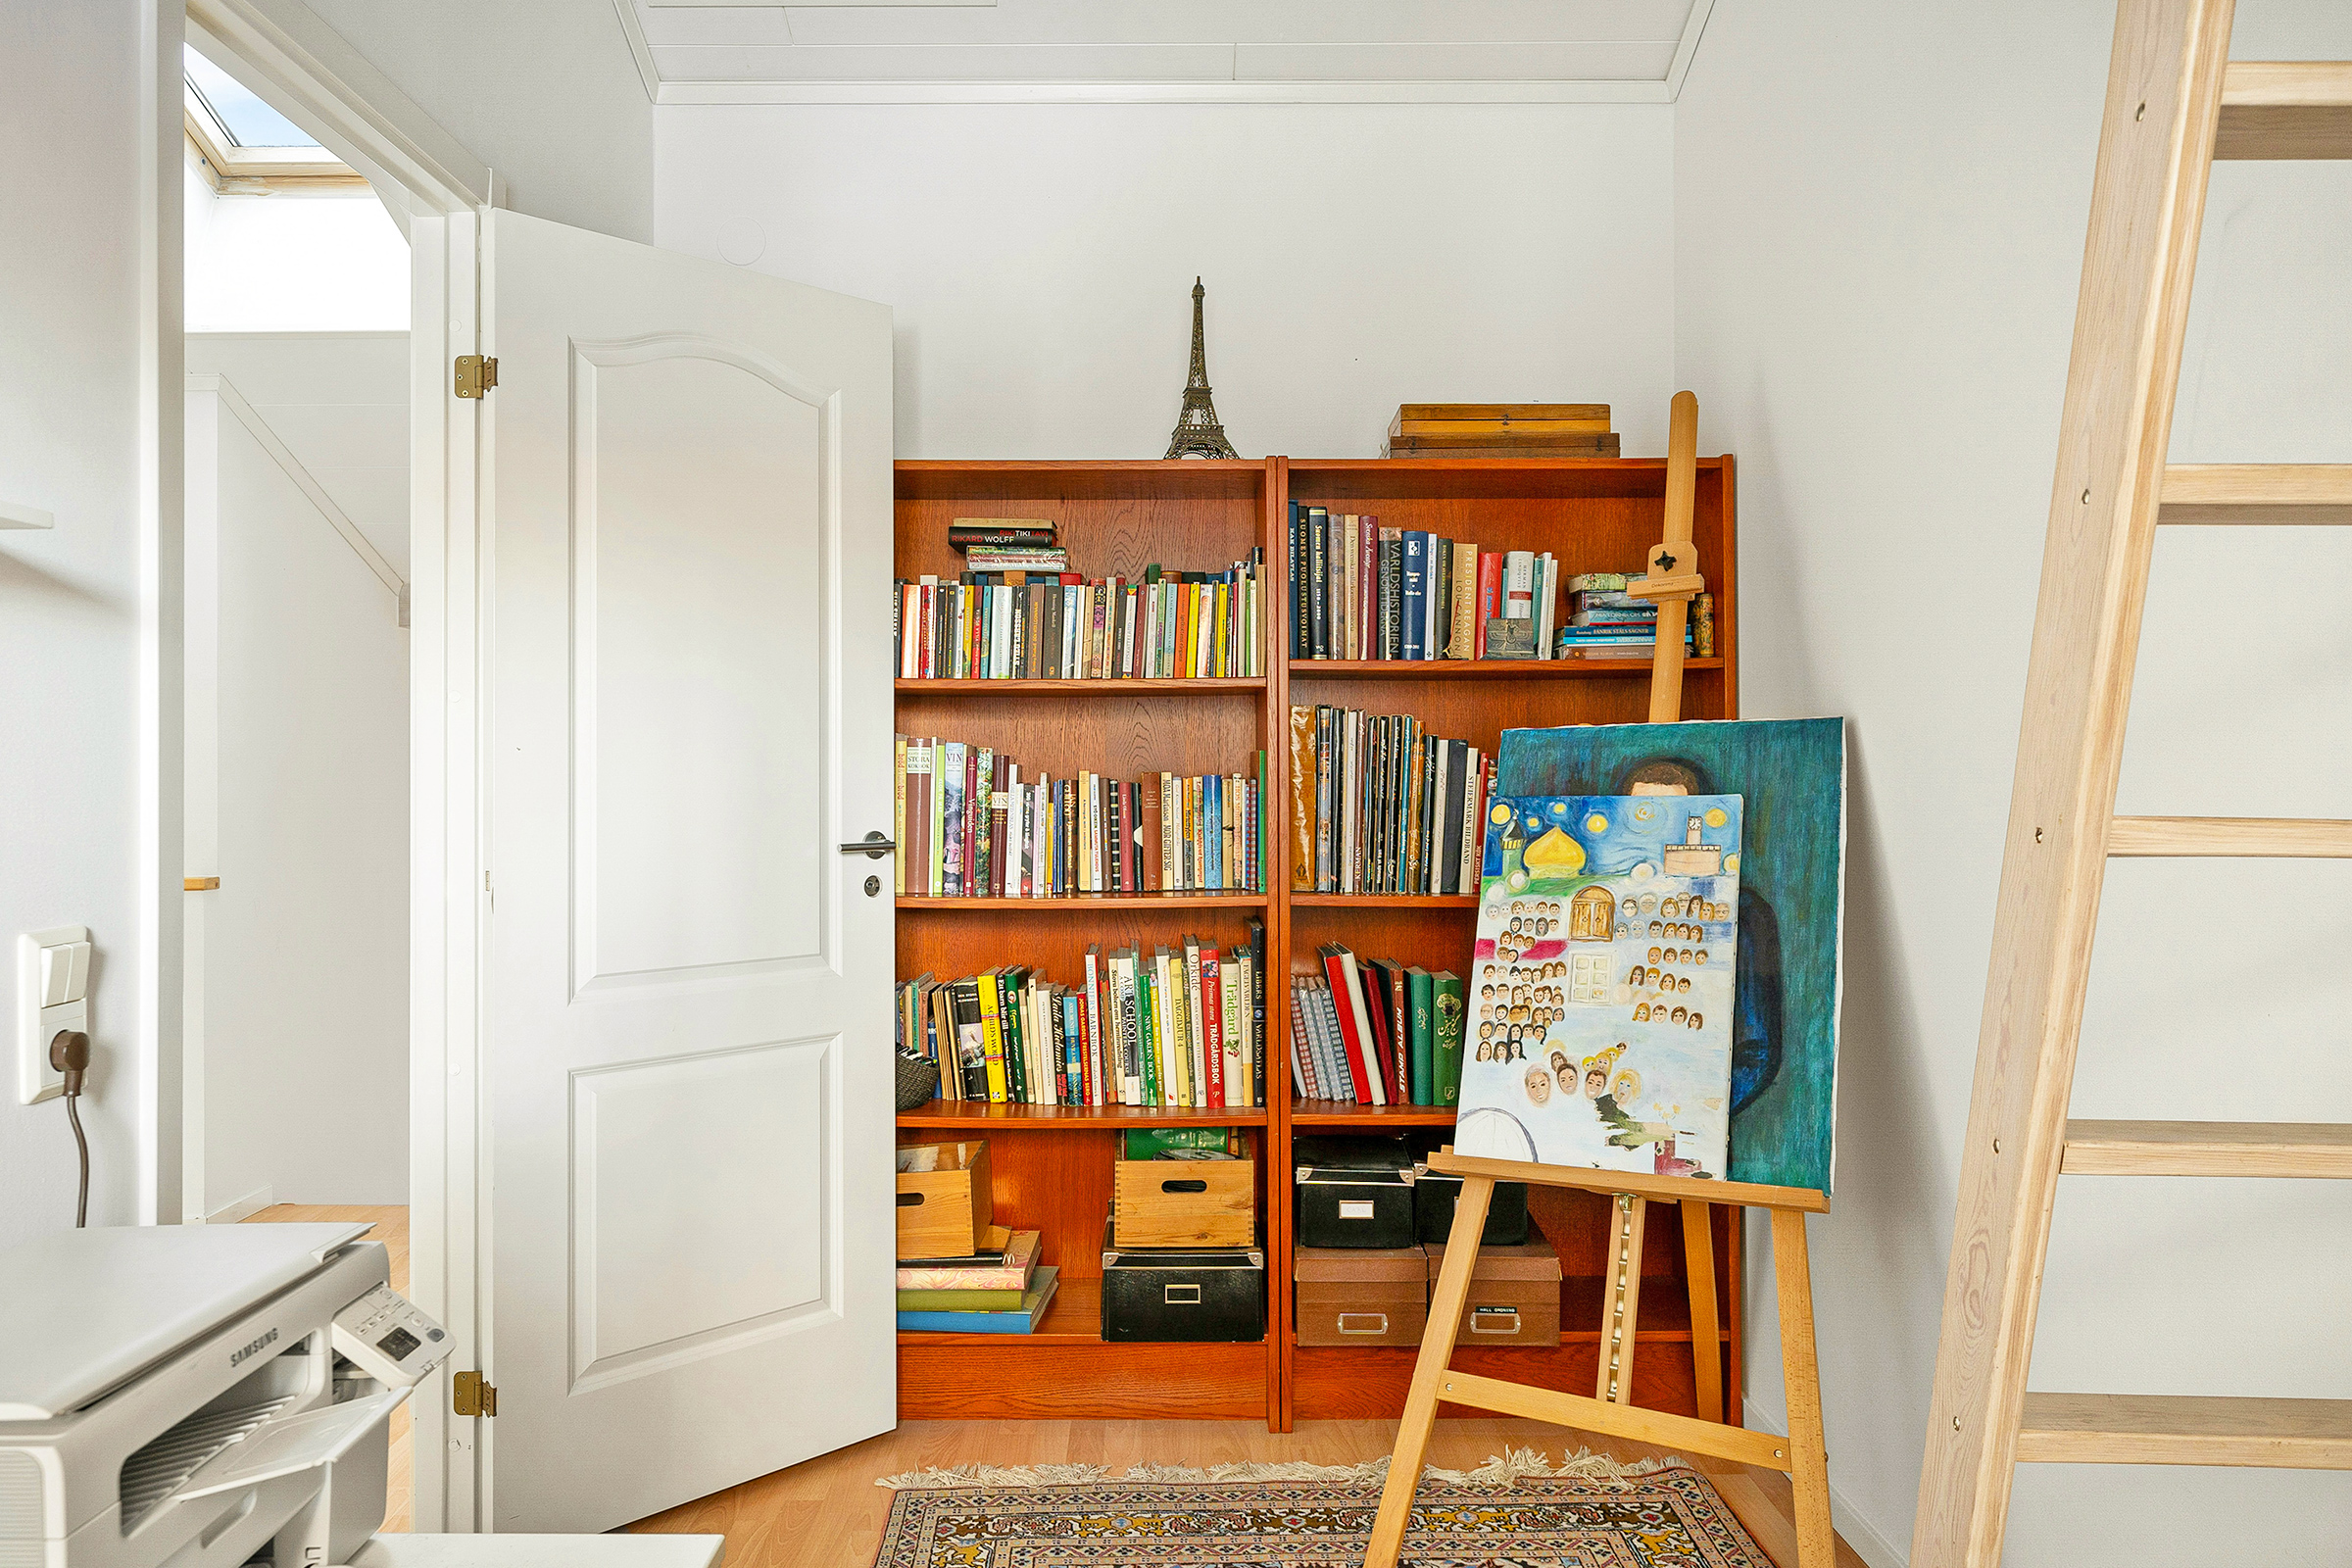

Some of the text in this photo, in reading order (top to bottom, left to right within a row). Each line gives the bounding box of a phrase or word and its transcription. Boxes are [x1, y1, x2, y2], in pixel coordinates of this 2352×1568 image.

[952, 535, 984, 544] RIKARD
[1314, 524, 1323, 550] Suomen
[1464, 551, 1473, 605] PRESIDENT
[1390, 542, 1401, 654] VÄRLDSHISTORIEN
[947, 753, 963, 762] VIN
[966, 799, 976, 834] Vinguiden
[1163, 839, 1172, 860] GIFTER
[1187, 954, 1200, 992] Orkidé
[1052, 996, 1063, 1022] Laila
[1207, 980, 1216, 1004] Prismas
[1225, 980, 1239, 1035] Trädgård
[1124, 975, 1137, 1046] ART SCHOOL
[1209, 1023, 1220, 1085] TRÄDGÅRDSBOK
[230, 1328, 279, 1368] SAMSUNG
